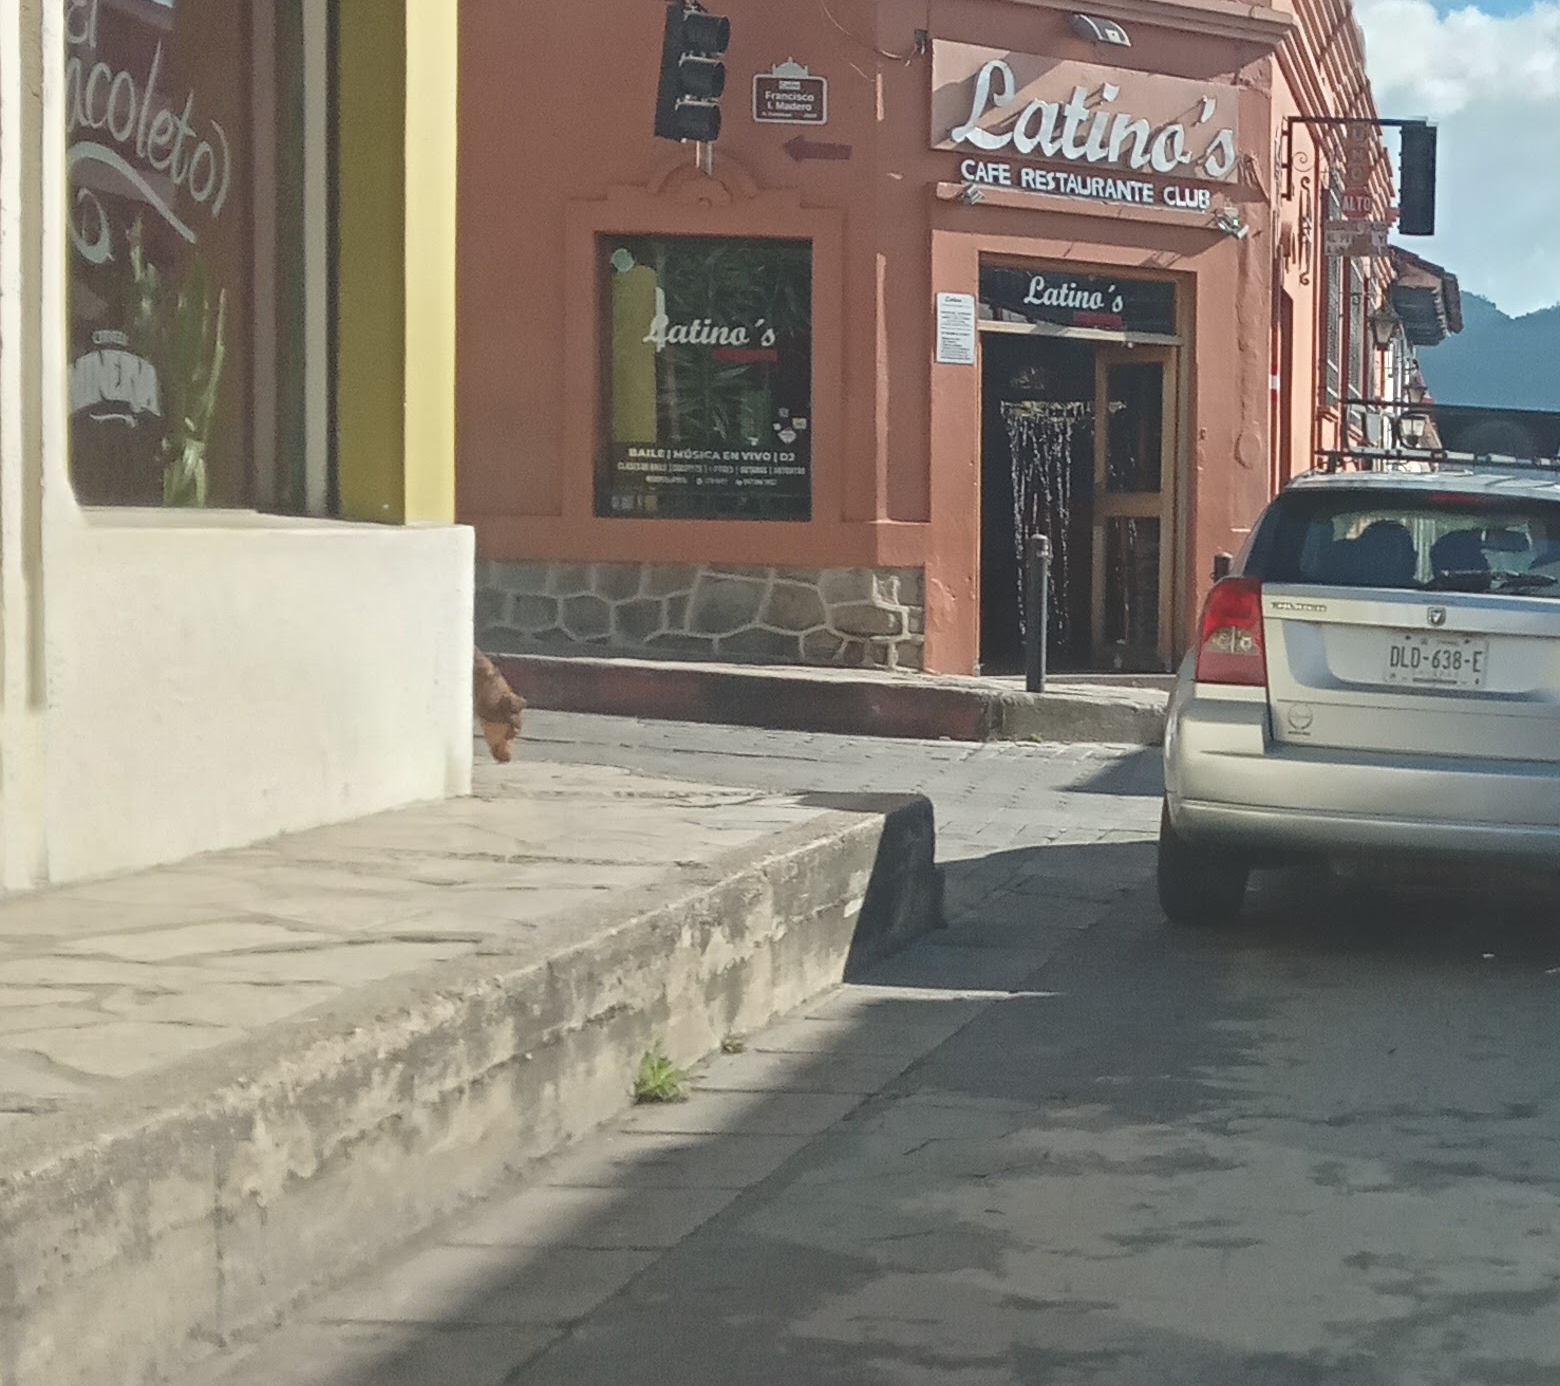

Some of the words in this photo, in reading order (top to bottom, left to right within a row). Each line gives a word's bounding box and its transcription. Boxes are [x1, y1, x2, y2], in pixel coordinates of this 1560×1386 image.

[765, 90, 815, 102] Francisco
[776, 101, 812, 112] Madero
[961, 159, 1011, 186] CAFE
[1021, 167, 1155, 204] RESTAURANTE
[1163, 186, 1211, 210] CLUB
[1341, 196, 1372, 213] ALTO
[628, 448, 665, 459] BAILE
[673, 448, 720, 461] MÚSICA
[722, 451, 740, 461] EN
[741, 451, 771, 462] VIVO
[1390, 645, 1483, 673] DLD-638-E
